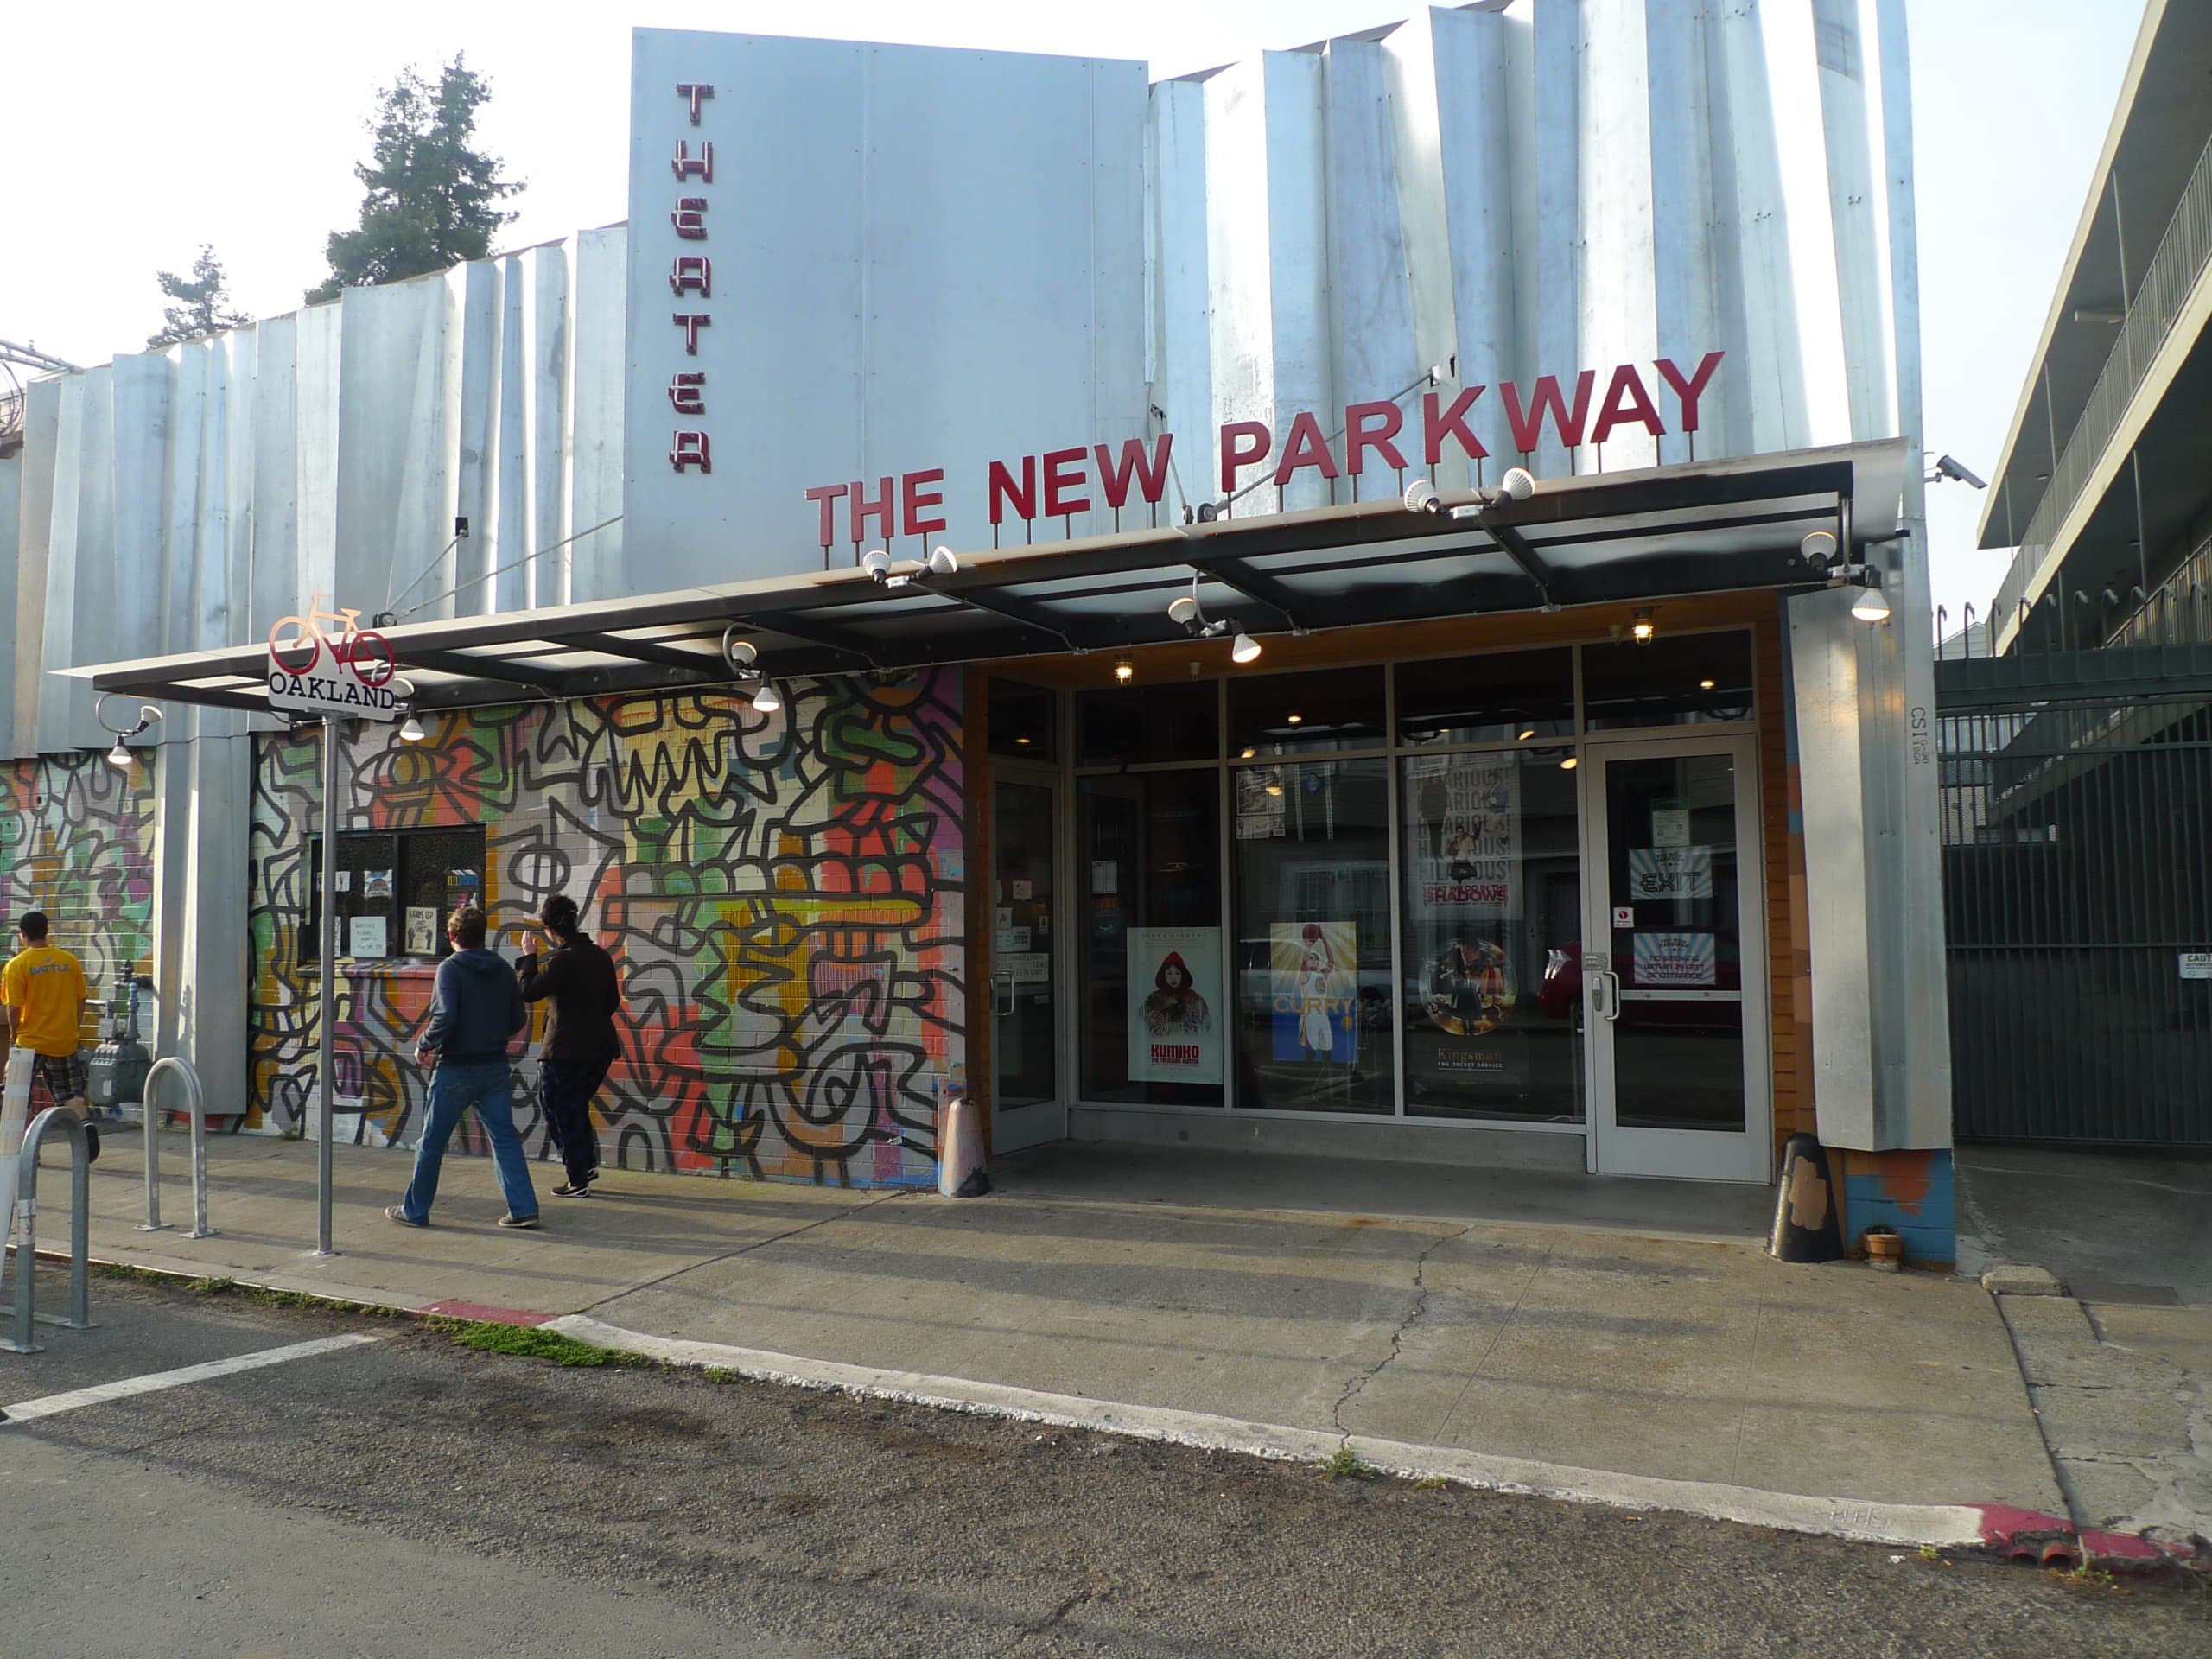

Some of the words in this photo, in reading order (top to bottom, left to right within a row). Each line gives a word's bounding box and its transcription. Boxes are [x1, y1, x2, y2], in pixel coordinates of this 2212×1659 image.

[670, 83, 716, 474] THEATER
[806, 469, 945, 548] THE
[989, 435, 1170, 524] NEW
[1221, 353, 1722, 493] PARKWAY
[269, 671, 395, 709] OAKLAND
[1911, 707, 1928, 737] CSI
[1641, 871, 1701, 893] EXIT
[1273, 995, 1355, 1014] CURRY
[1151, 1044, 1199, 1058] KUMIKO
